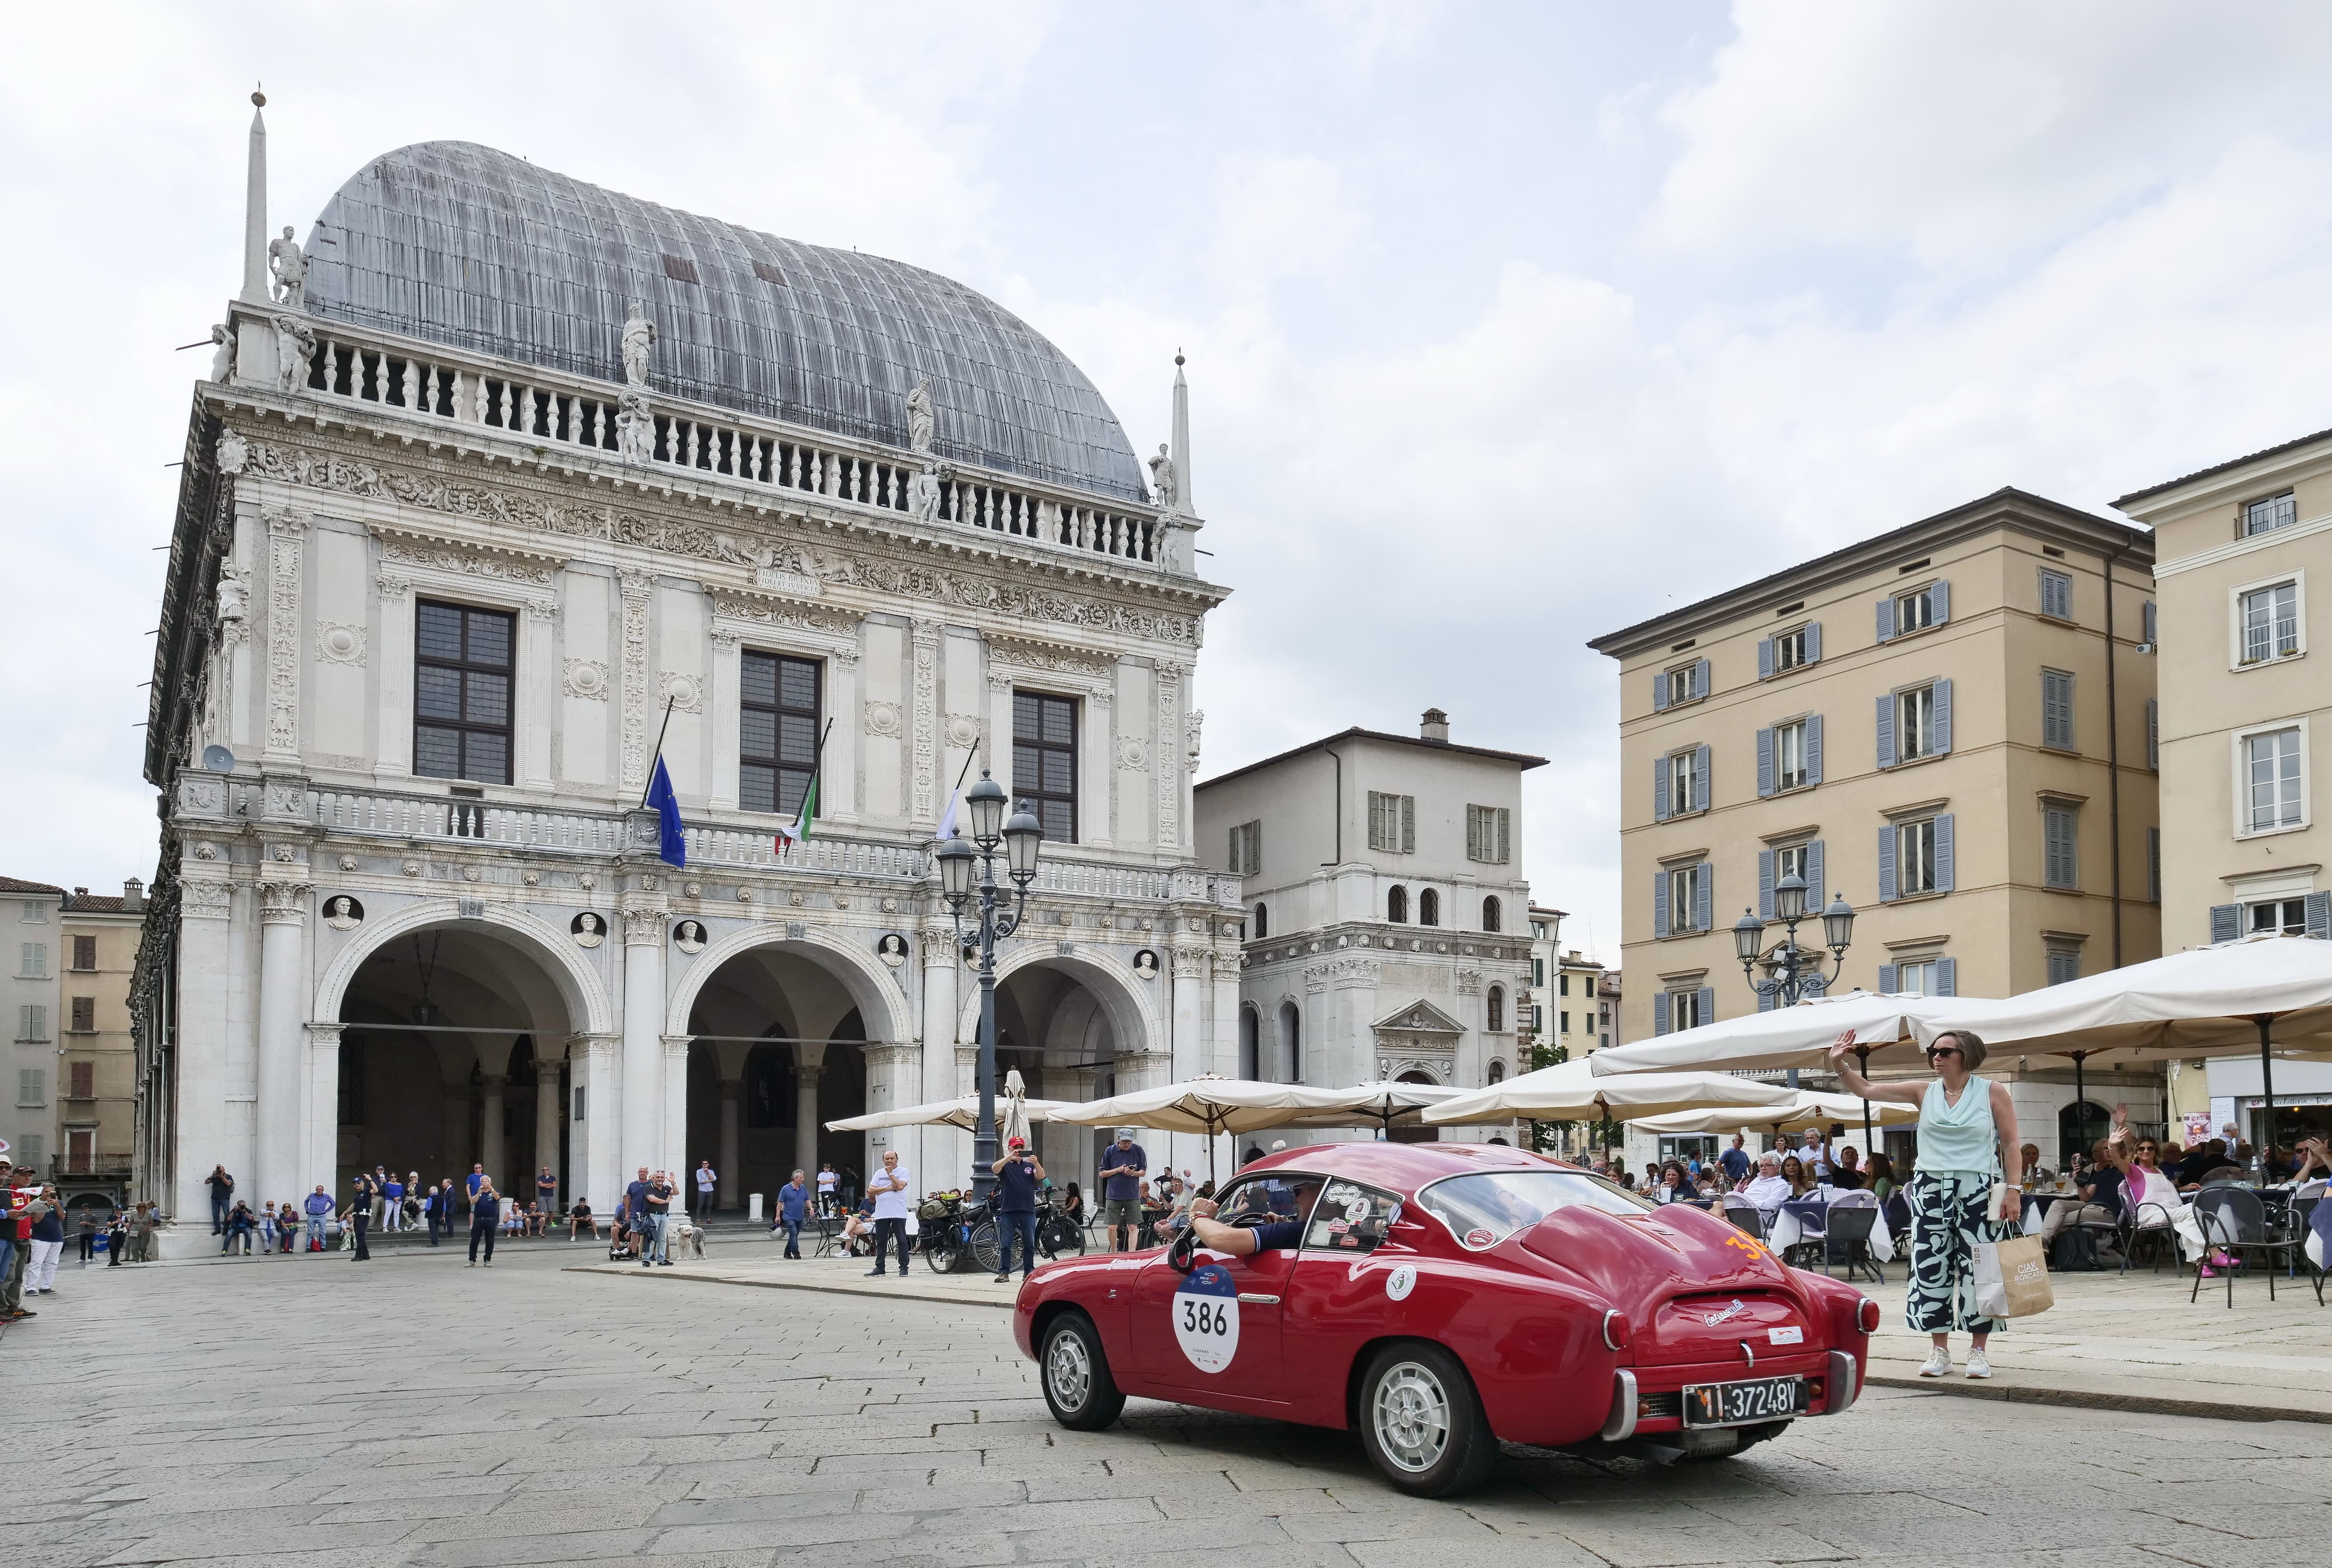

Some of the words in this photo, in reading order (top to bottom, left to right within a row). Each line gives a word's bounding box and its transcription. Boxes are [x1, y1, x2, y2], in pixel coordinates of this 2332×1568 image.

[758, 569, 786, 580] FIDELIS
[2316, 1096, 2328, 1104] Bar
[2017, 1261, 2039, 1274] CIAK
[2014, 1270, 2044, 1282] RONCATO
[1184, 1300, 1227, 1336] 386
